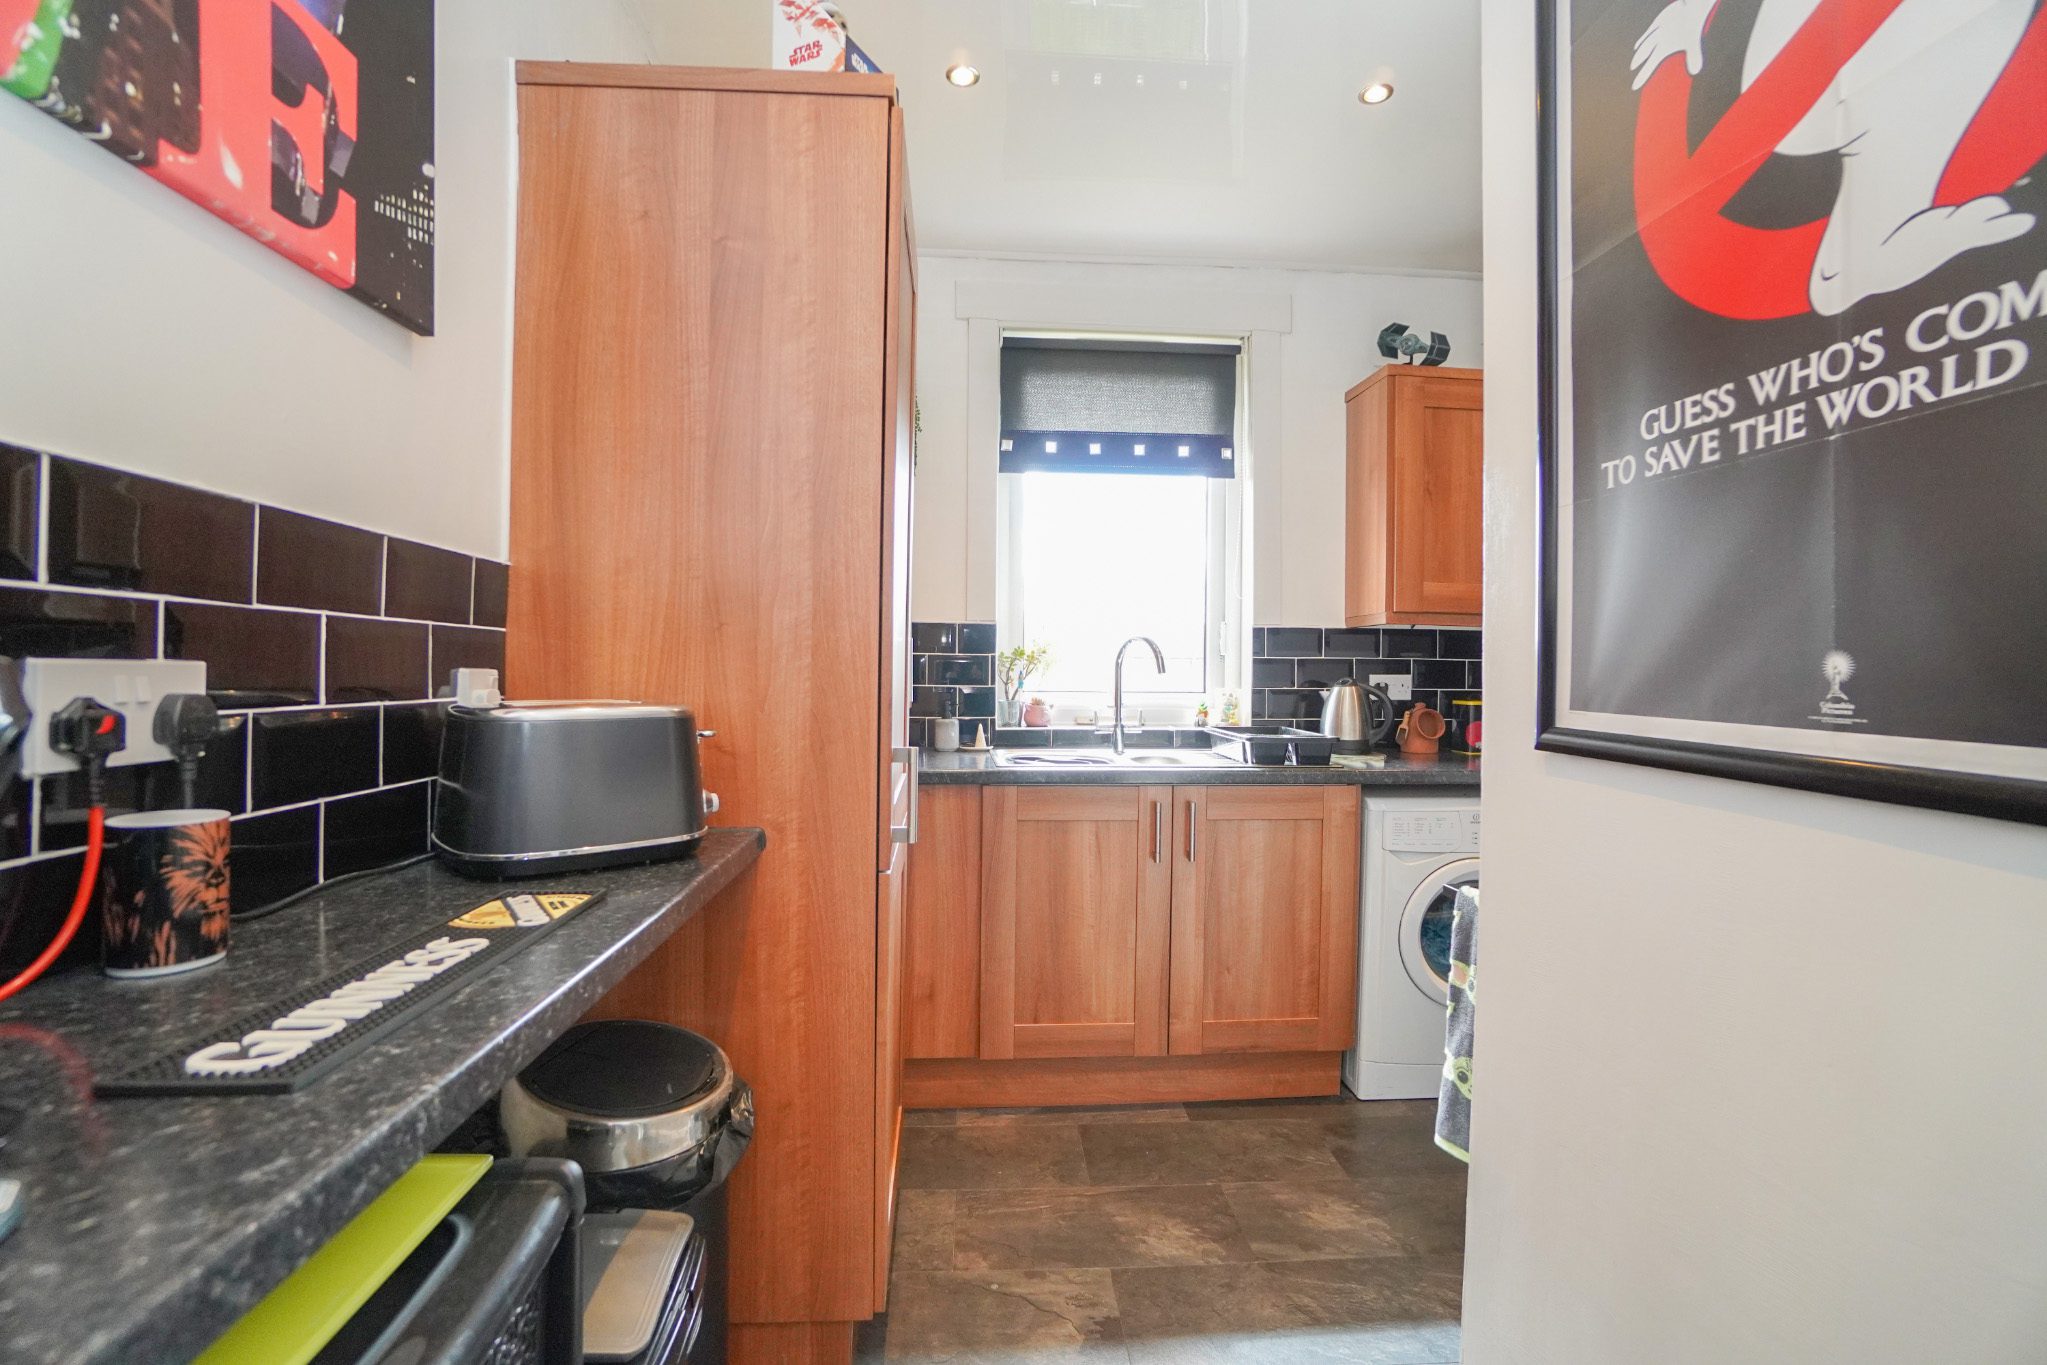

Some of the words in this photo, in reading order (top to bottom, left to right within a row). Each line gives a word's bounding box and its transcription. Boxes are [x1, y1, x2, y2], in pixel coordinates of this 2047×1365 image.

[789, 40, 823, 57] STAR
[789, 48, 823, 67] WARS
[1601, 455, 1636, 489] TO
[1644, 433, 1721, 477] SAVE
[1729, 402, 1807, 455] THE
[1815, 339, 2029, 430] WORLD
[1640, 383, 1736, 441] GUESS
[1747, 328, 1885, 406] WHO'S
[184, 937, 490, 1075] GUINNESS
